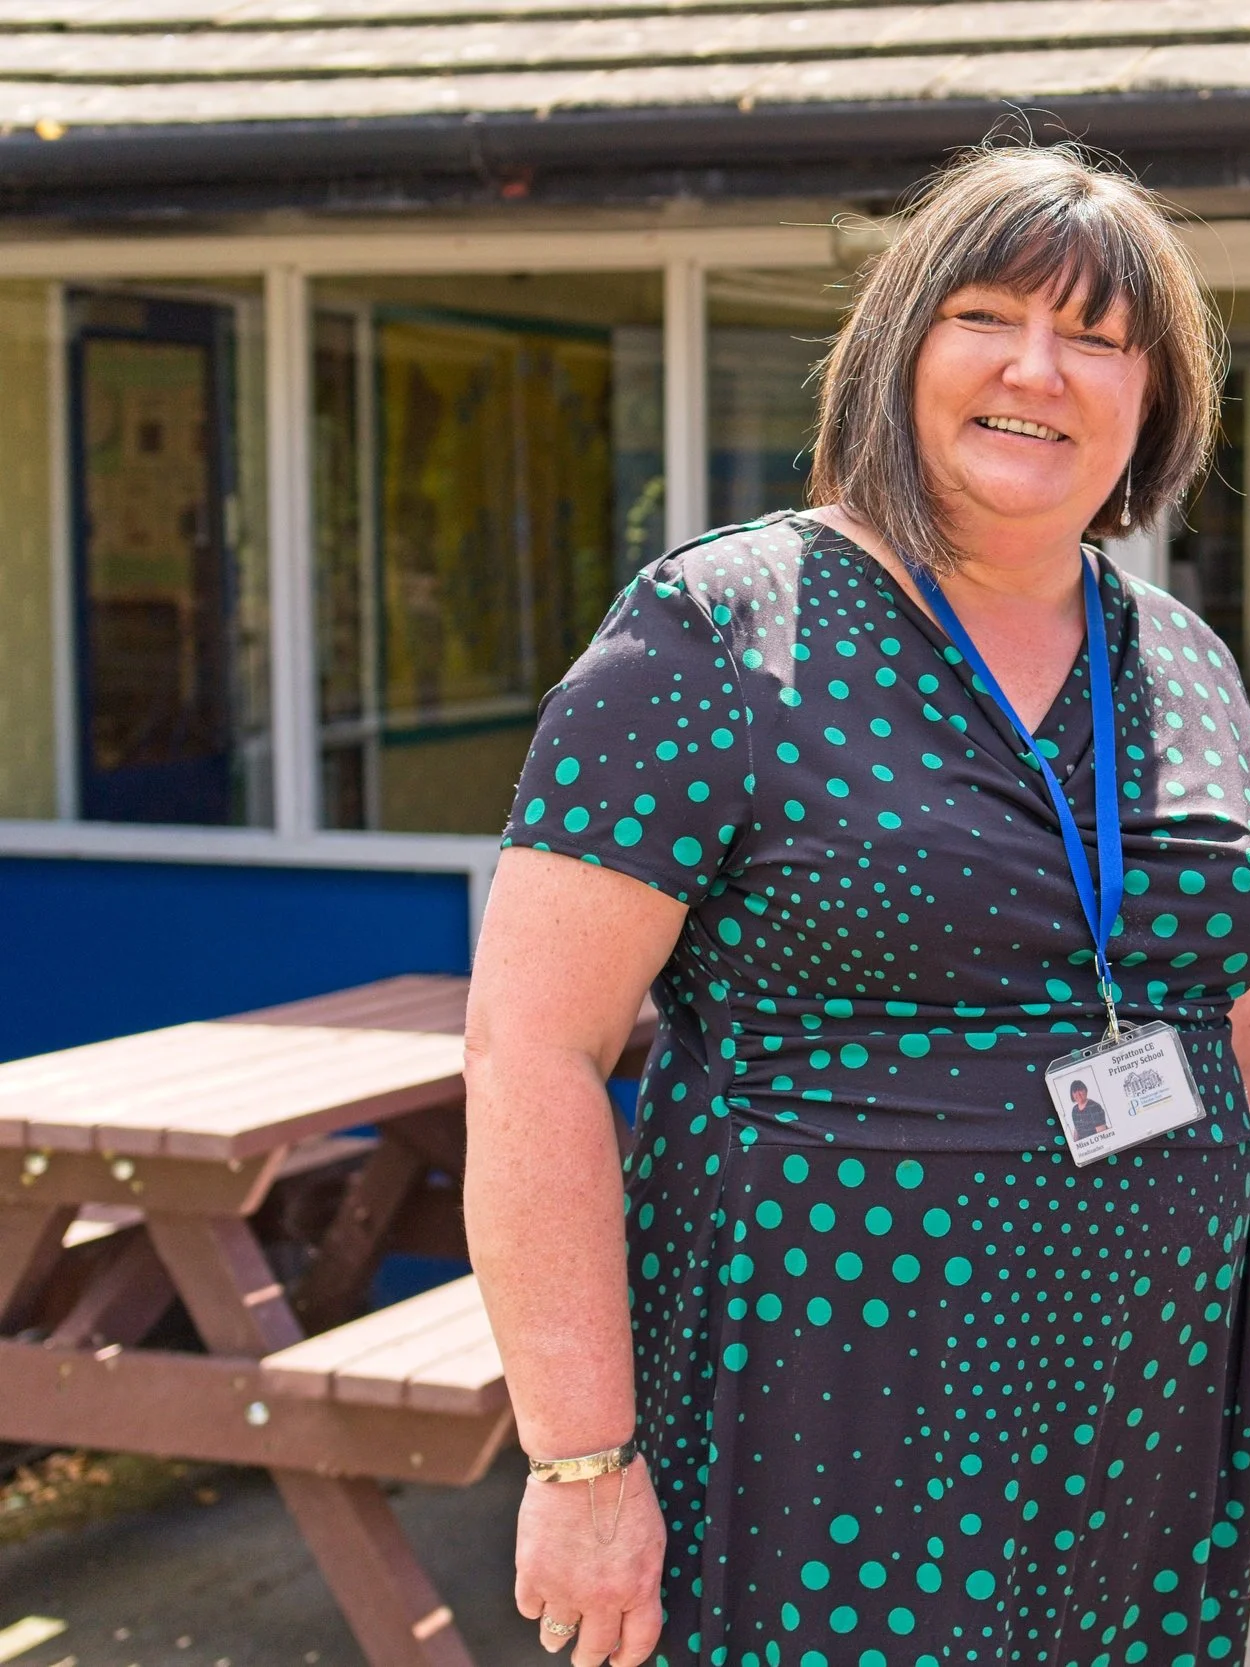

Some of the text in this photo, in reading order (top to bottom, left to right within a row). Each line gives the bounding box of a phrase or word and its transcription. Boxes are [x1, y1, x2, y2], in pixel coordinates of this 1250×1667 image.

[1108, 1049, 1164, 1076] Primary School
[1112, 1042, 1155, 1064] Spratton CE
[1076, 1141, 1090, 1149] Miss
